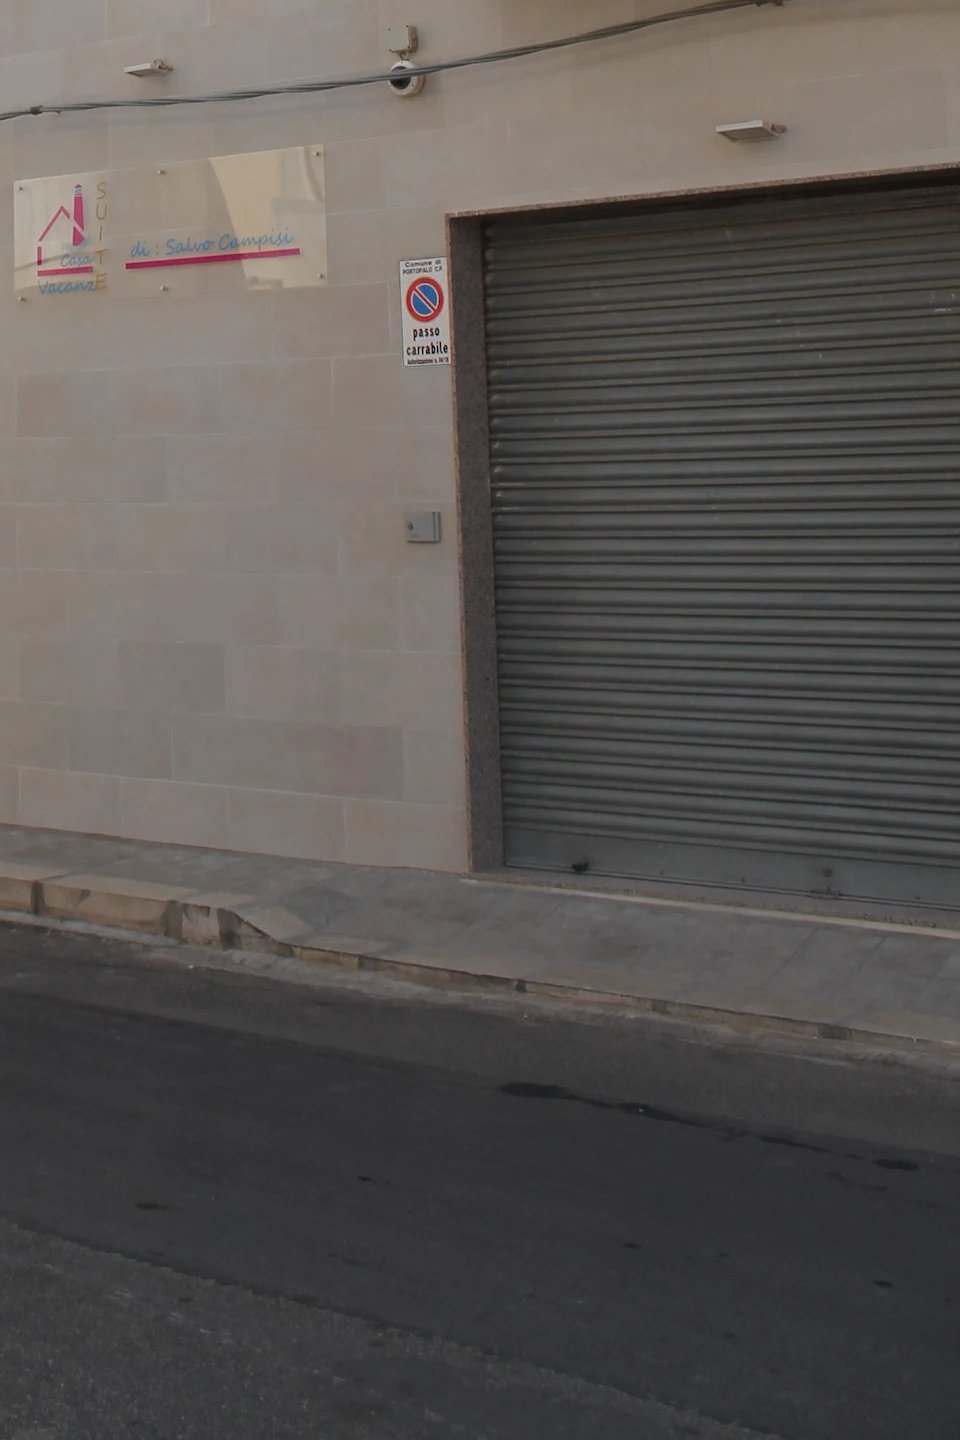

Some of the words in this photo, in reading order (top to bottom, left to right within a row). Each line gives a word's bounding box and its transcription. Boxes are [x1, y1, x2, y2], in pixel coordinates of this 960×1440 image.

[95, 181, 109, 291] SUITE
[131, 240, 151, 258] di
[166, 237, 215, 256] Salvo
[218, 227, 295, 252] Campisi
[60, 253, 93, 268] Casa
[403, 267, 433, 275] PORTOPALO
[413, 327, 440, 342] passo
[406, 341, 448, 356] carrabile
